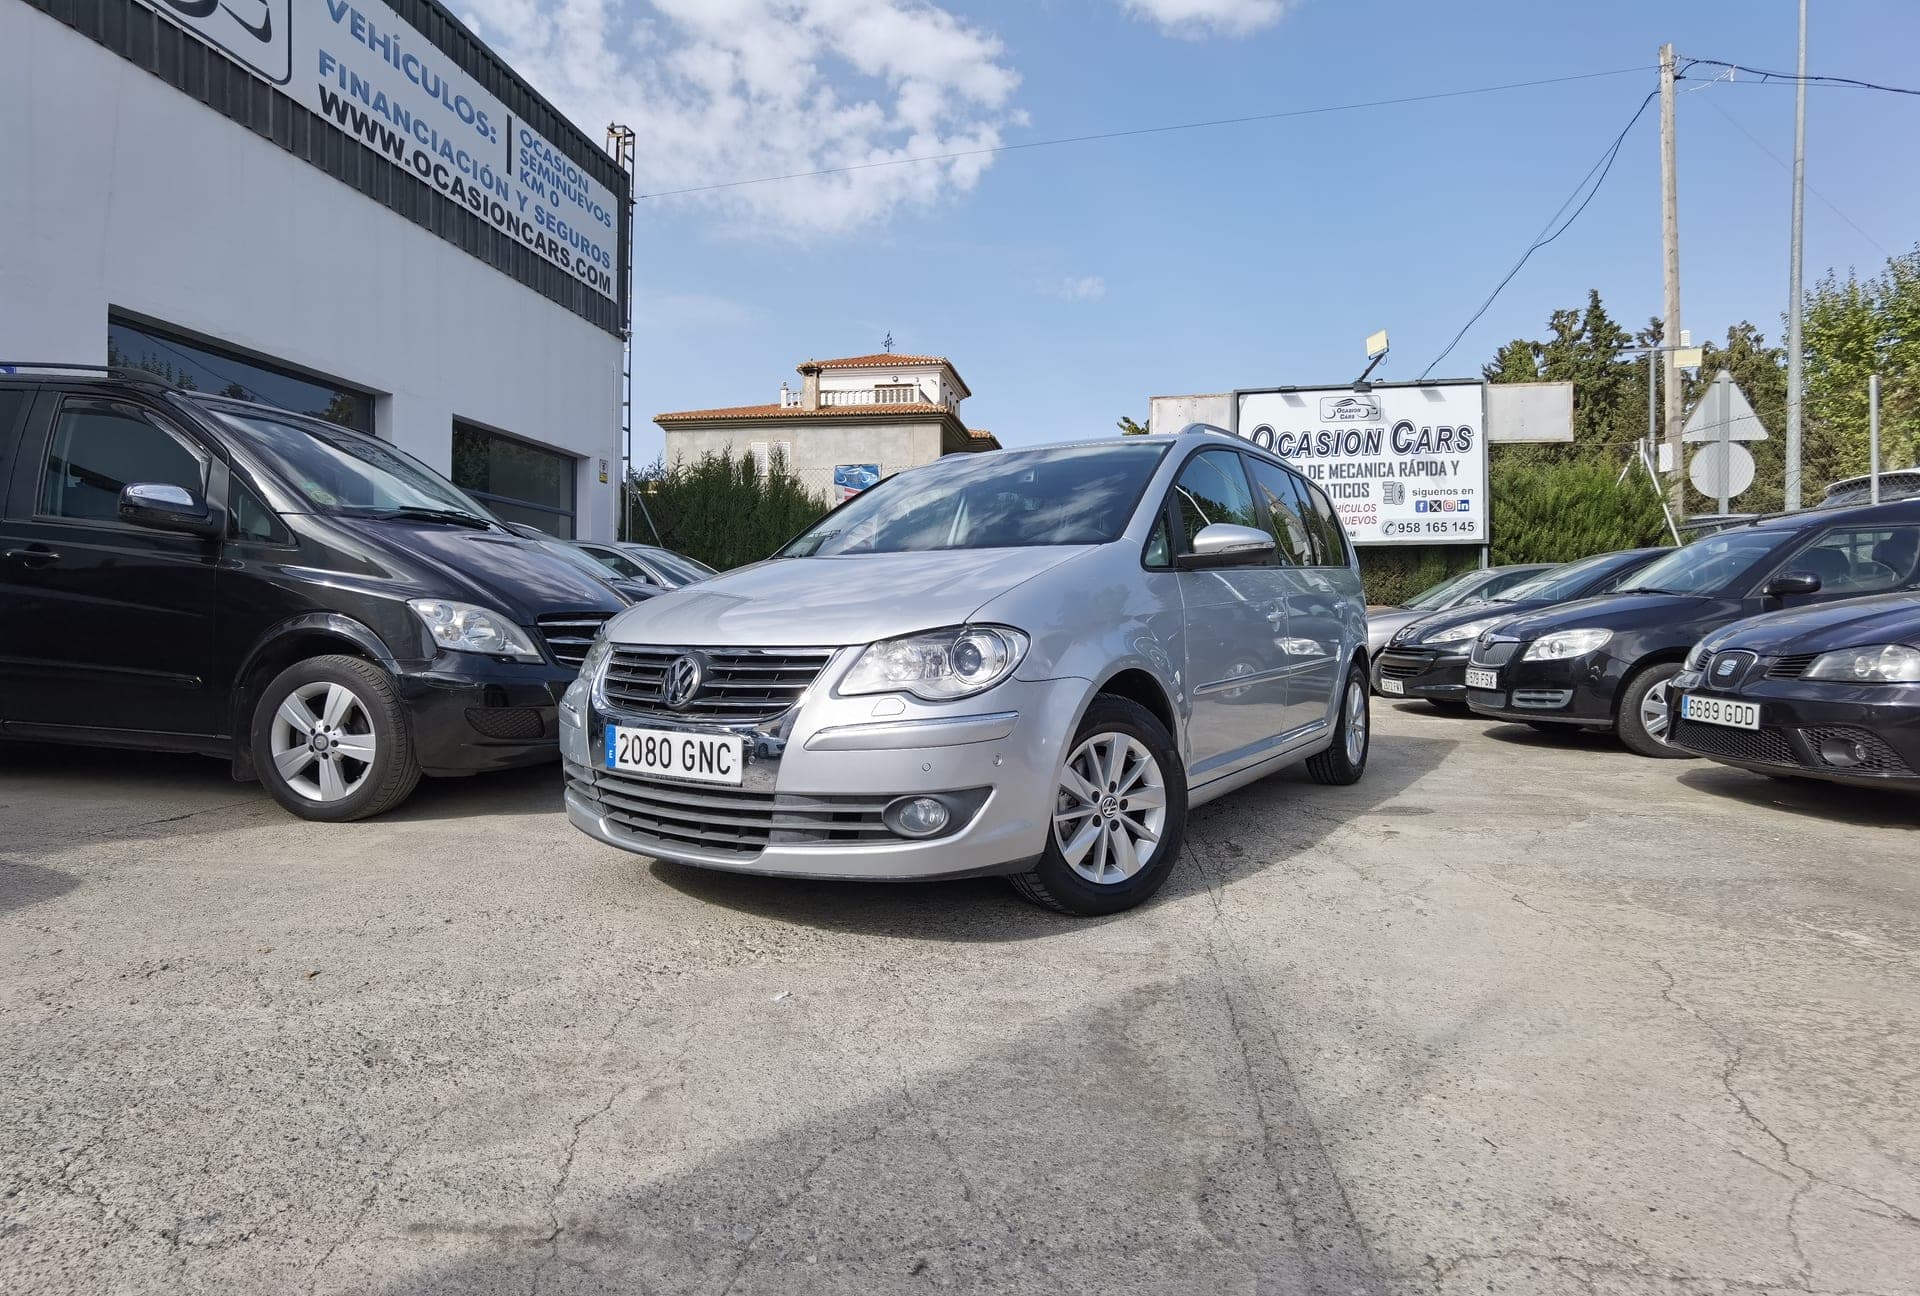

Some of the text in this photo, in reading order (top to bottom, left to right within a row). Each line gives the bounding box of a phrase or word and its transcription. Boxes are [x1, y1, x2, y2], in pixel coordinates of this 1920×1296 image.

[327, 0, 497, 144] VEHÍCULOS:
[319, 49, 611, 269] FINANCIACIÓN Y SEGUROS
[519, 129, 589, 194] OCASION
[318, 83, 611, 294] WWW.OCASIONCARS.COM
[519, 150, 612, 228] SEMINUEVOS
[520, 166, 545, 198] KM
[1250, 419, 1475, 458] OCASION CARS
[1308, 464, 1325, 480] DE
[1328, 461, 1395, 480] MECANICA
[1399, 459, 1447, 477] RÁPIDA
[1450, 460, 1460, 476] Y
[1321, 482, 1370, 499] ATICOS
[1336, 503, 1377, 513] HÍCULOS
[1398, 521, 1475, 533] 958 165 145
[1689, 699, 1754, 725] 6689 GDD
[619, 733, 672, 769] 2080
[682, 739, 731, 775] GNC
